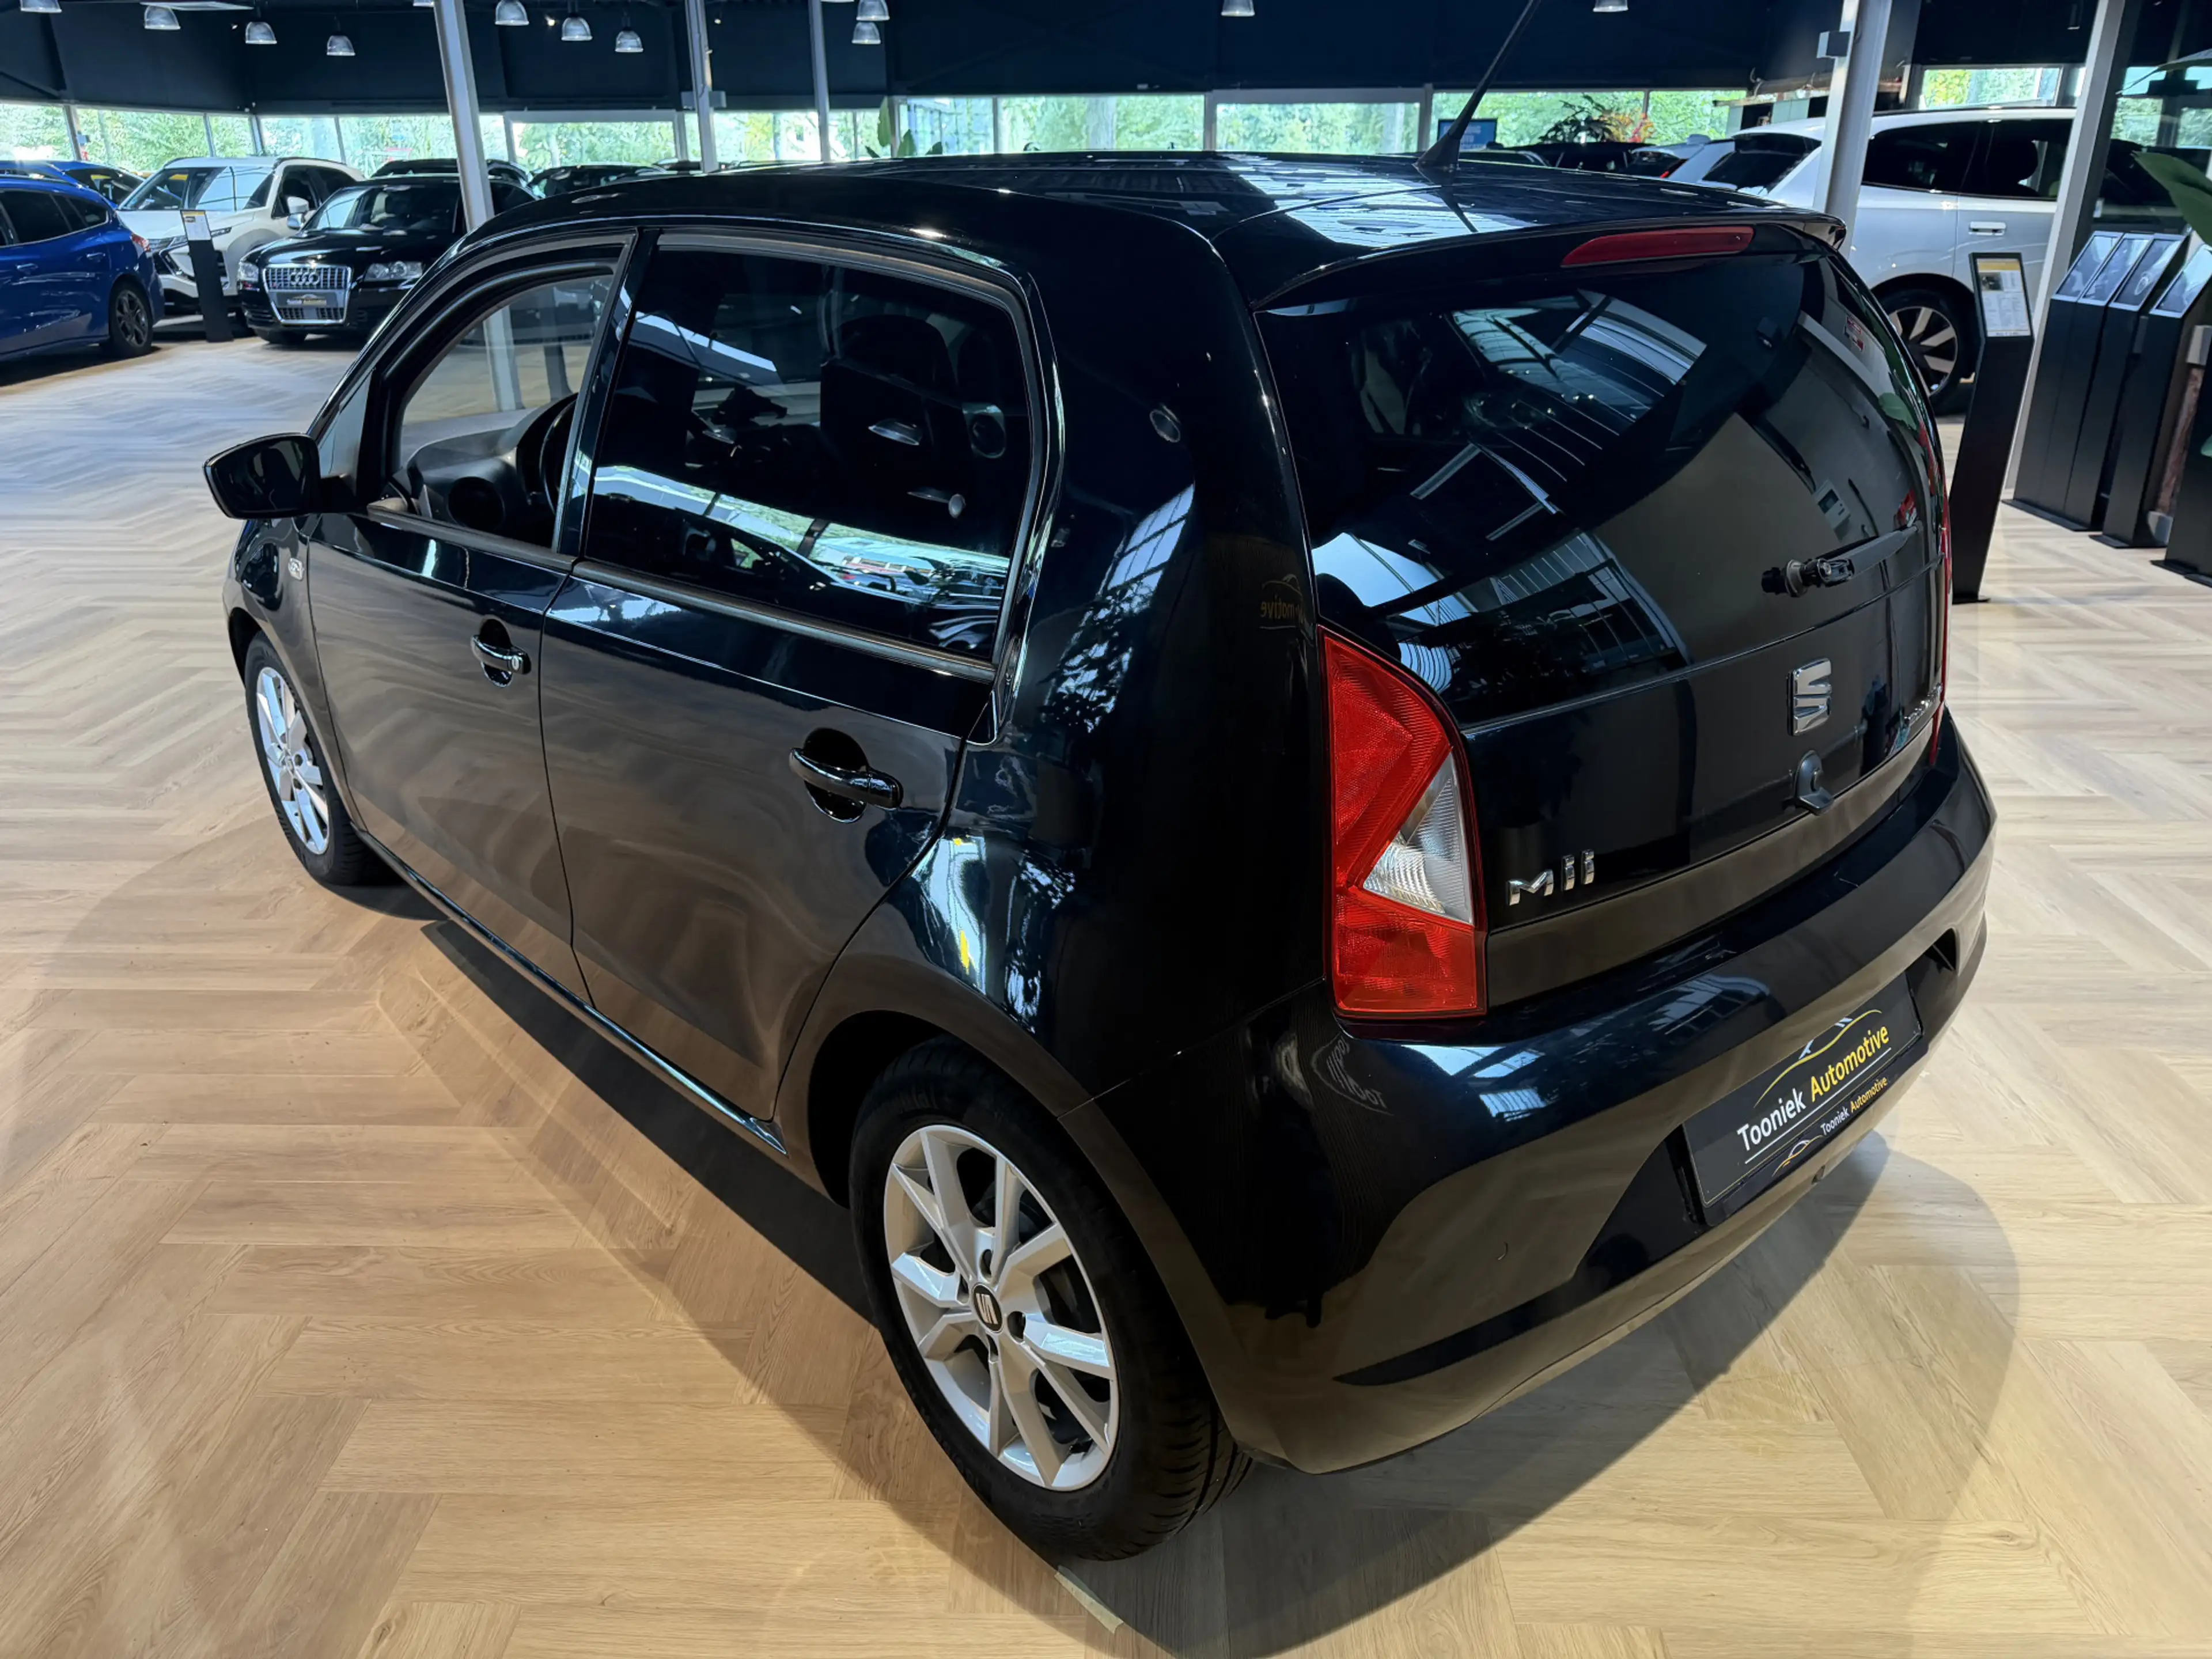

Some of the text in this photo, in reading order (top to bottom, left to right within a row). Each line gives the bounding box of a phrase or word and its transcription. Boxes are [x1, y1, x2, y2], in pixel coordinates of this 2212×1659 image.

[1737, 1026, 1889, 1151] Tooniek Automotive
[1820, 1077, 1888, 1135] Tooniek Automotive
